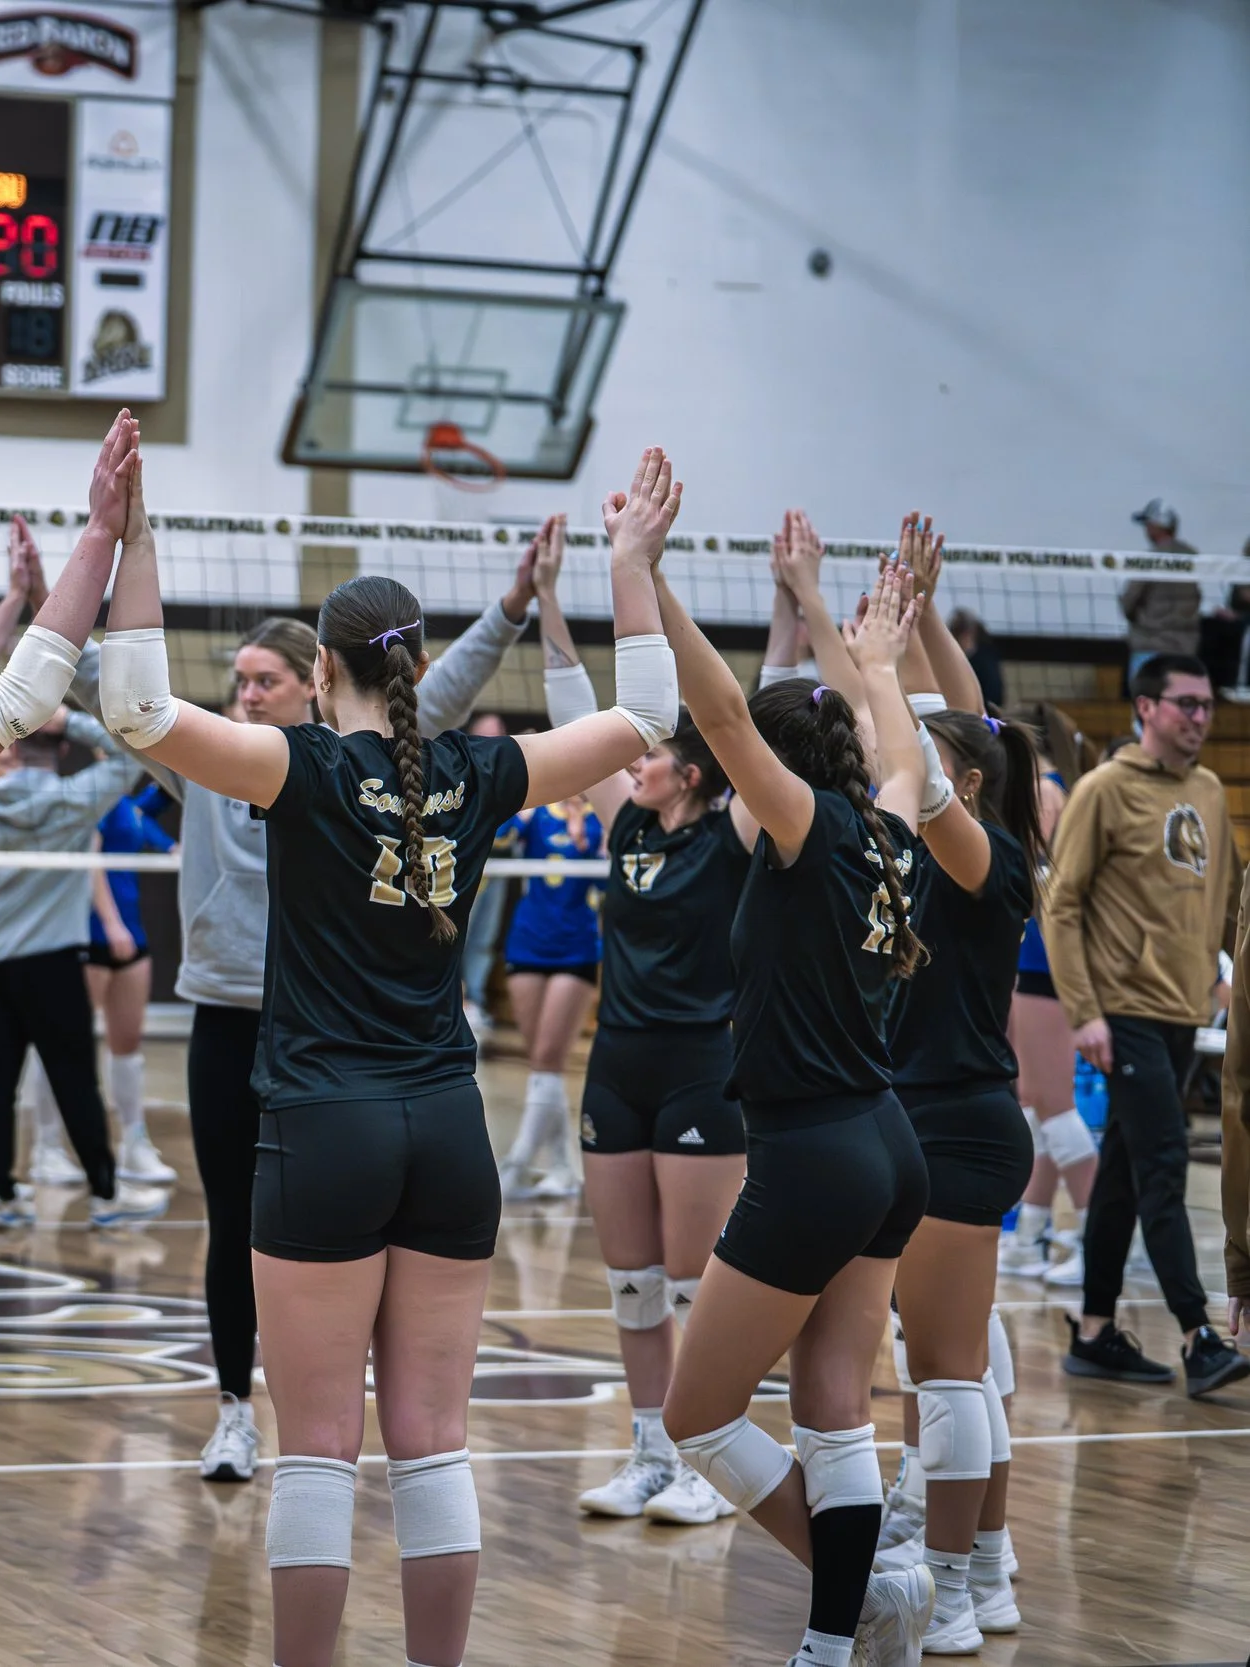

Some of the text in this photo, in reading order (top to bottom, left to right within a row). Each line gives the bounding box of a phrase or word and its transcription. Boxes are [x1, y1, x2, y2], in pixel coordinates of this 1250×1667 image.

[0, 281, 64, 308] FOULS
[1, 364, 63, 388] SCORE
[163, 515, 265, 533] VOLLEYBALL
[369, 835, 458, 907] 10
[622, 852, 666, 893] 17
